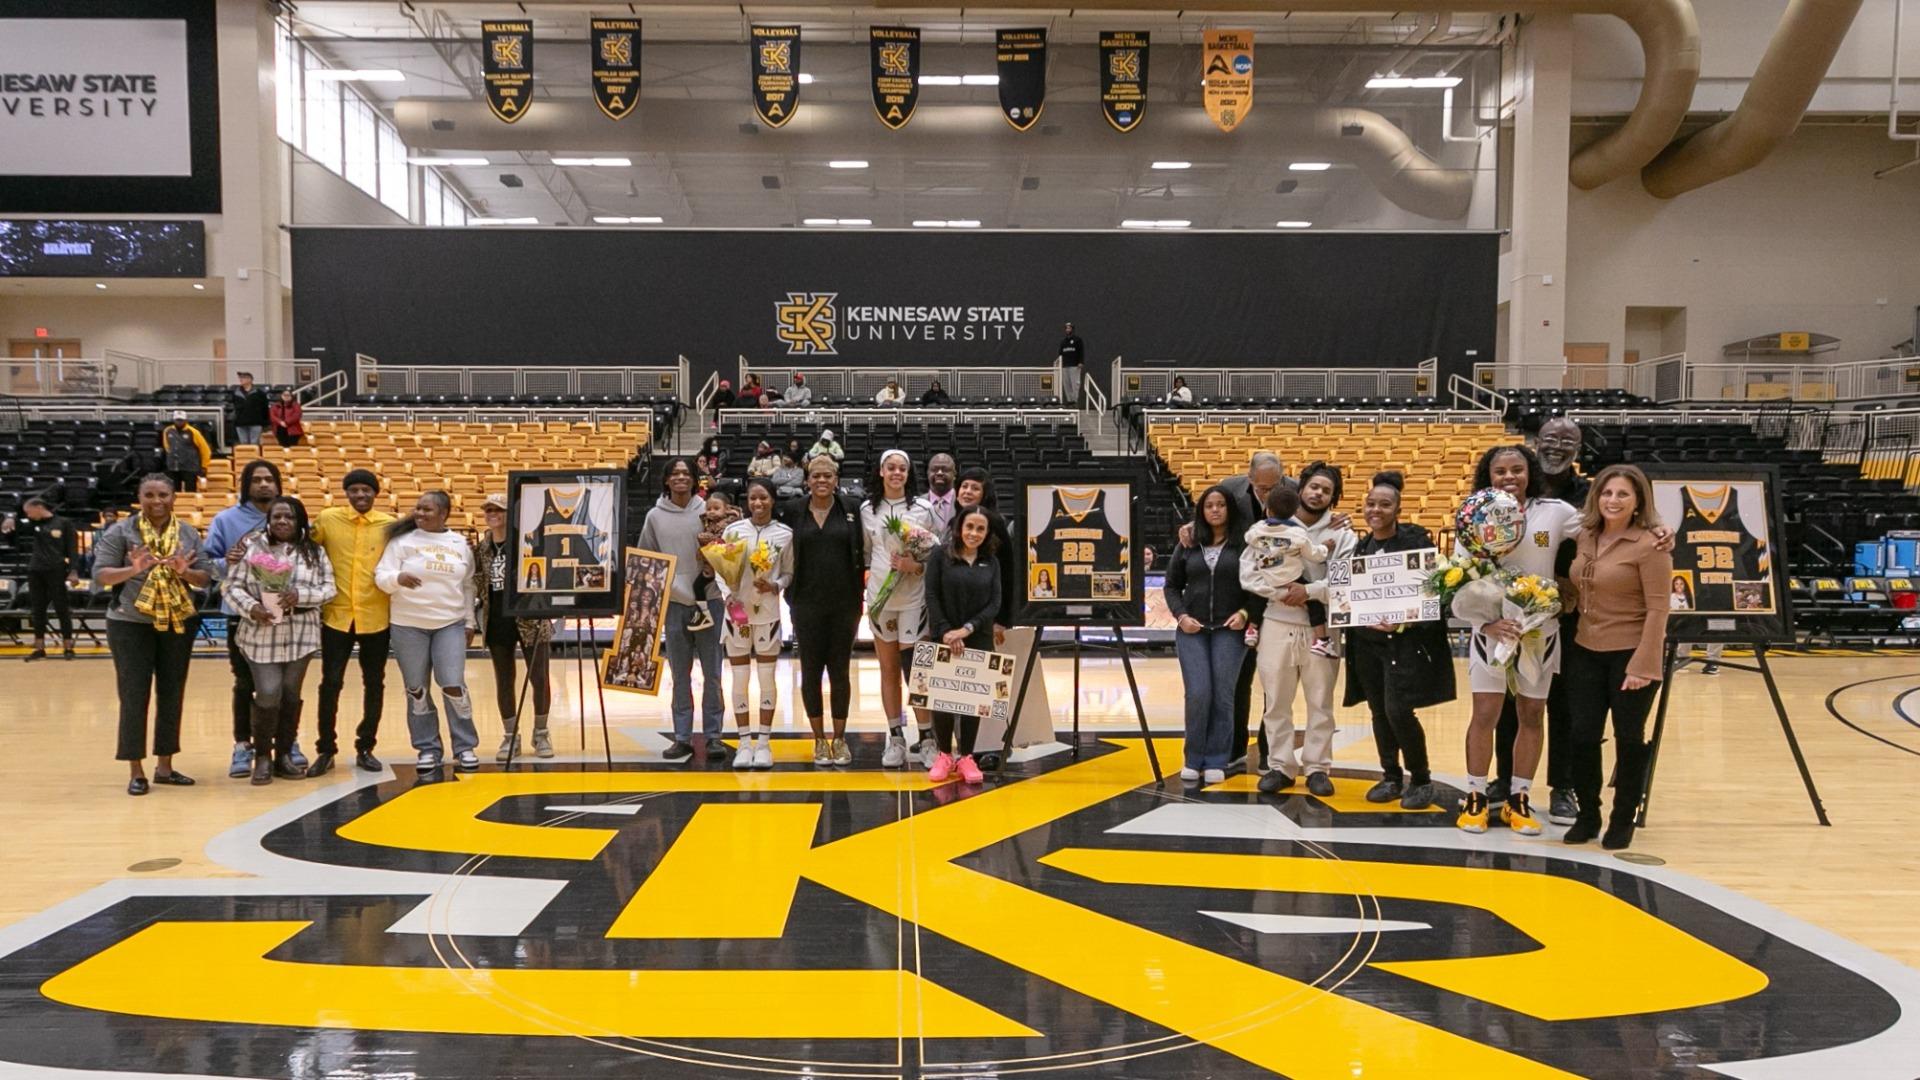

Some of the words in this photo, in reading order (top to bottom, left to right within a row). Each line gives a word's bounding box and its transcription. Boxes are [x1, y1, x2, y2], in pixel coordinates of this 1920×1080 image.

[484, 23, 530, 32] VOLLEYBALL
[593, 21, 640, 30] VOLLEYBALL
[753, 28, 799, 37] VOLLEYBALL
[872, 30, 918, 39] VOLLEYBALL
[1002, 33, 1041, 41] VOLLEYBALL
[1102, 39, 1147, 47] BASKETBALL
[1208, 43, 1250, 51] BASKETBALL
[83, 74, 157, 93] STATE
[847, 306, 962, 322] KENNESAW
[967, 306, 1025, 322] STATE
[847, 325, 1025, 341] UNIVERSITY
[1483, 520, 1523, 543] BEST
[560, 536, 571, 556] 1
[1696, 545, 1735, 569] 32
[425, 560, 455, 574] STATE
[1330, 561, 1349, 585] 22
[1374, 574, 1393, 584] GO
[1423, 601, 1439, 620] 22
[914, 644, 935, 668] 22
[956, 666, 976, 678] GO
